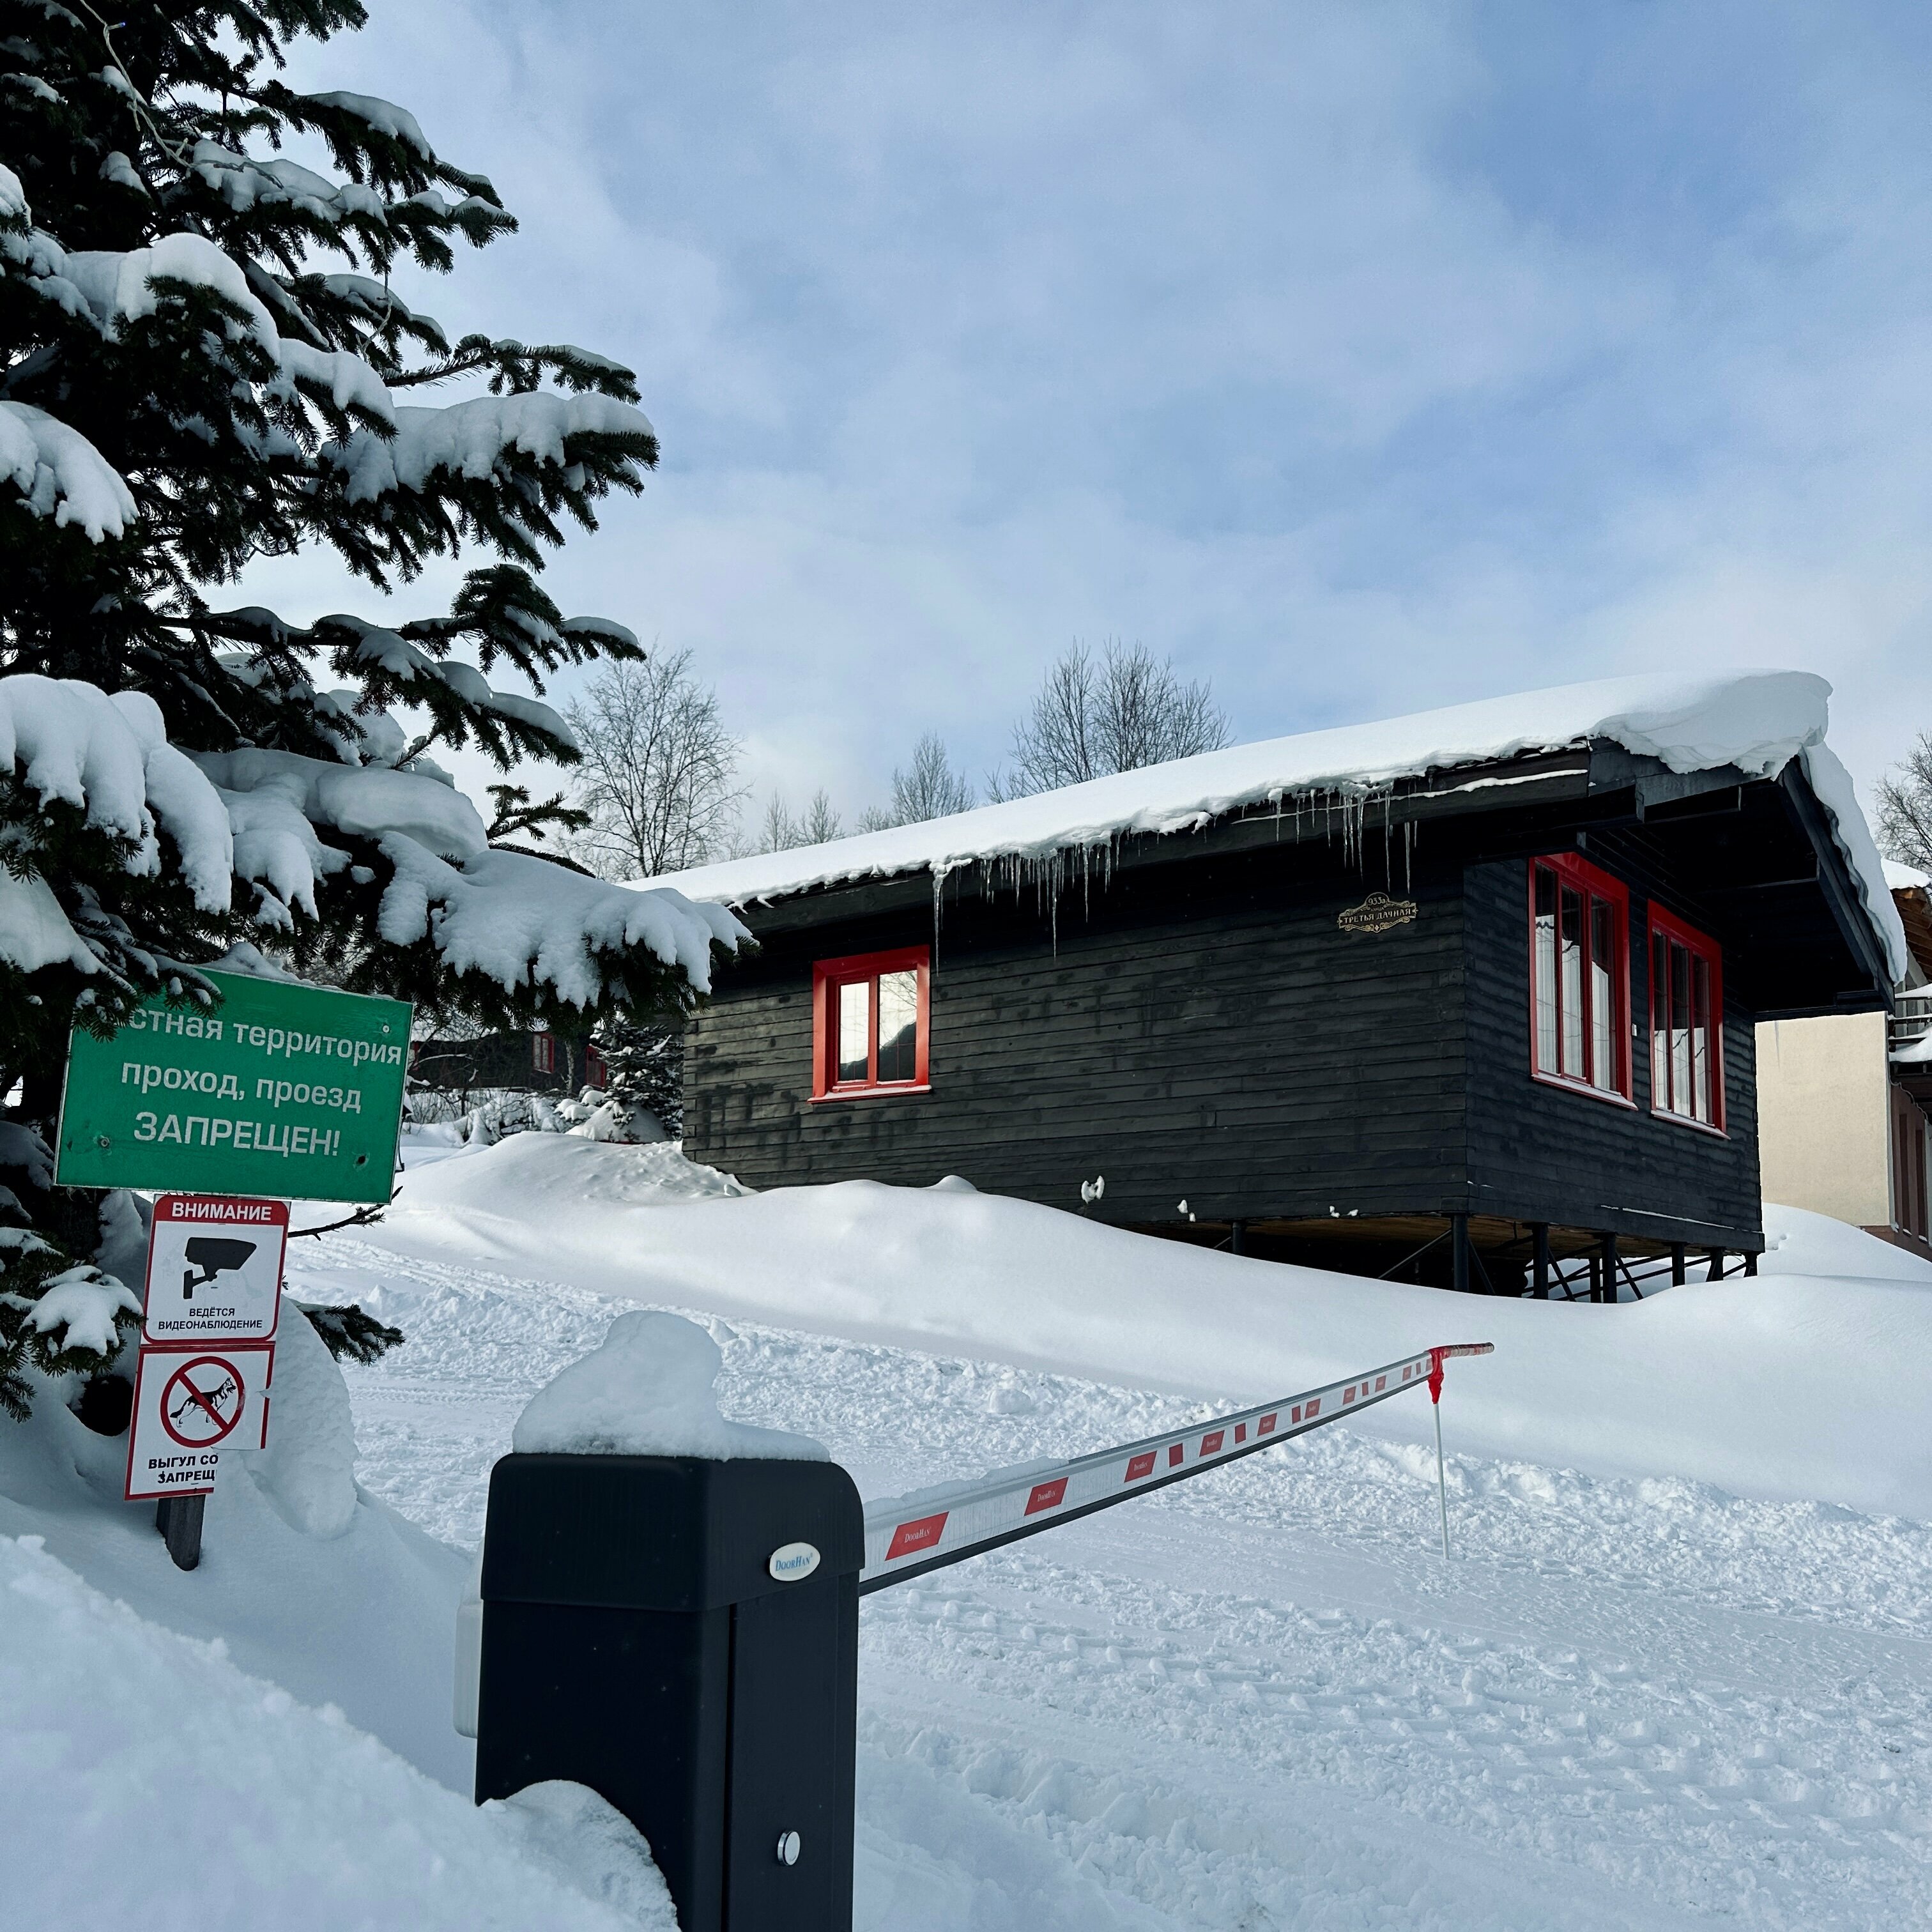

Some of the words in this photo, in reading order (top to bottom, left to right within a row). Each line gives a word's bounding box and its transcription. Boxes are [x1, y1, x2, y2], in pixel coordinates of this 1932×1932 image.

[1344, 914, 1374, 923] ТРЕТЬЯ
[1376, 908, 1411, 920] ДАЧНАЯ
[129, 1008, 223, 1041] стная
[233, 1022, 402, 1066] территория
[121, 1062, 245, 1101] проход,
[256, 1078, 362, 1114] проезд
[134, 1112, 341, 1158] ЗАПРЕЩЕН!
[172, 1202, 272, 1221] ВНИМАНИЕ
[189, 1307, 235, 1317] ВЕДЁТСЯ
[158, 1319, 263, 1331] ВИДЕОНАБЛЮДЕНИЕ
[148, 1455, 196, 1469] ВЫГУЛ
